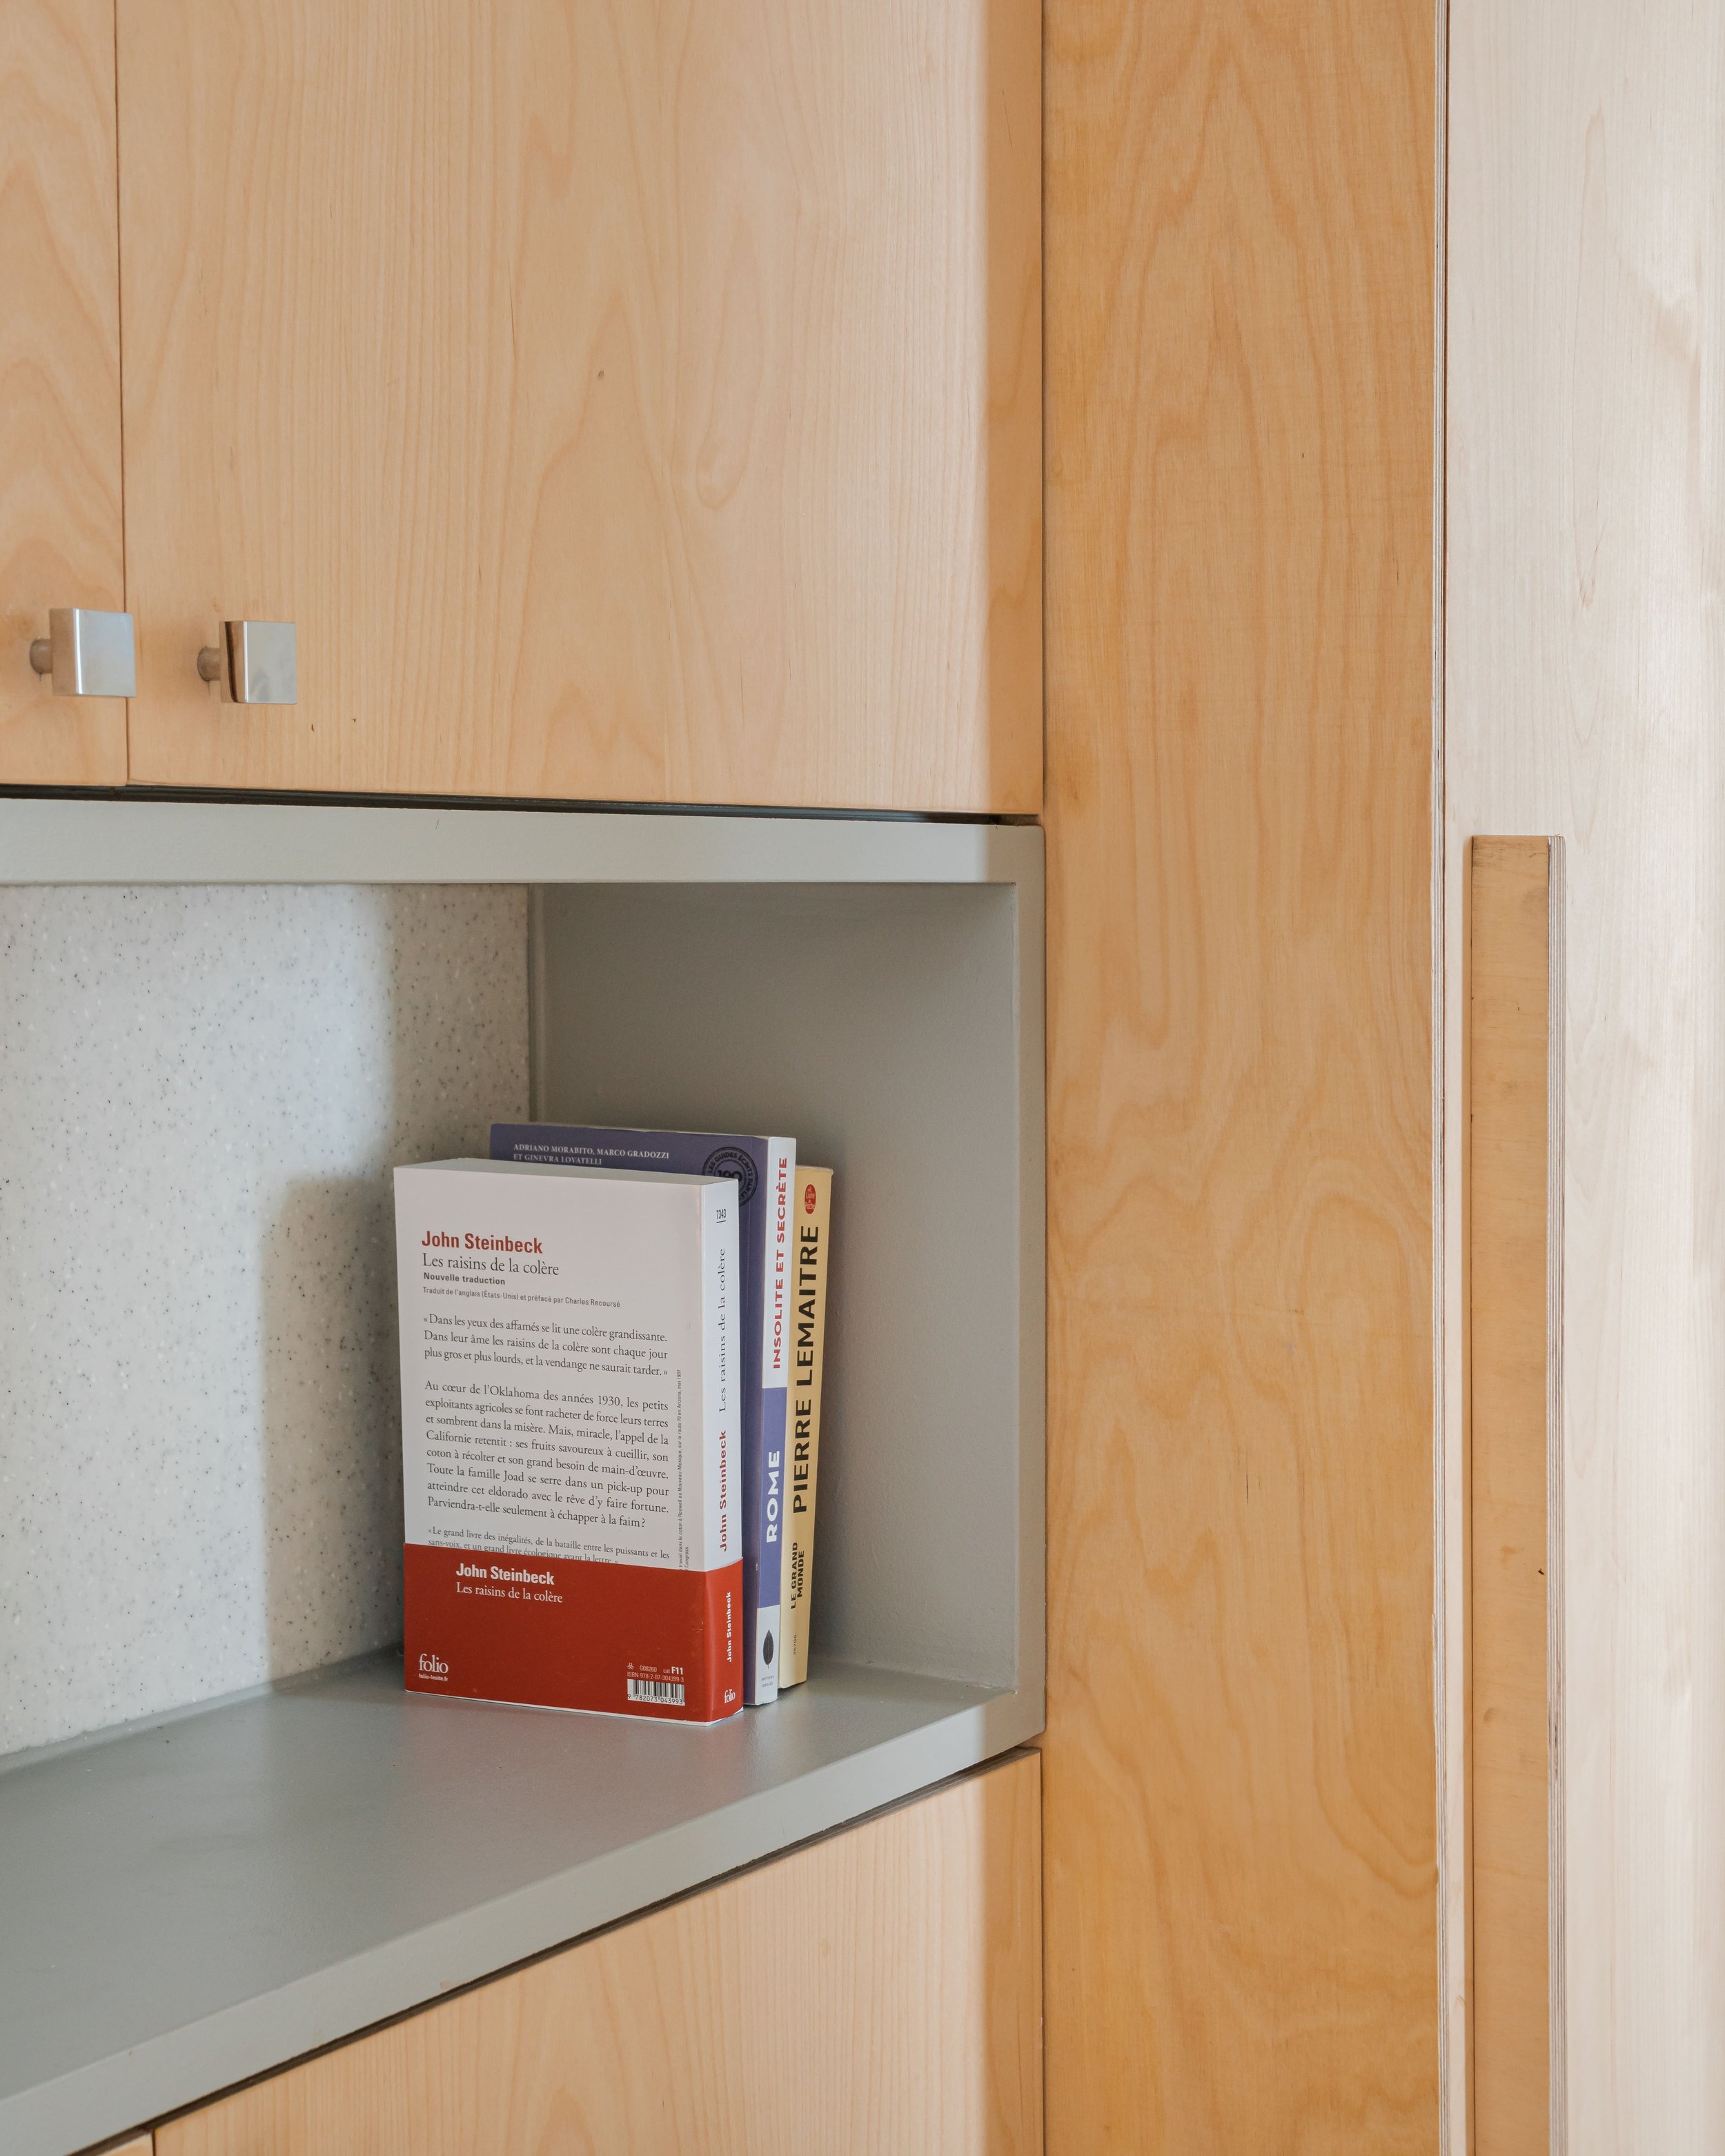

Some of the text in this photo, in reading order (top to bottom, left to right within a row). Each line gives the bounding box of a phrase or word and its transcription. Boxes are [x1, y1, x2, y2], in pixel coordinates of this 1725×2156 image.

[513, 1143, 669, 1159] ADRIANO MORABITO, MARCO GRADOZZI
[524, 1154, 559, 1164] GINEVRA
[561, 1156, 602, 1166] LOVATELLI
[716, 1209, 727, 1219] 7343
[422, 1231, 543, 1254] John Steinbeck
[423, 1253, 559, 1276] Les raisins de la colère
[773, 1158, 787, 1369] INSOLITE ET SECRÈTE
[424, 1272, 505, 1285] Nouvelle traduction
[423, 1286, 444, 1294] Traduit
[455, 1289, 480, 1298] l'anglais
[482, 1290, 518, 1300] (États-Unis)
[565, 1296, 589, 1305] Charles
[591, 1298, 620, 1307] Recoursé
[455, 1315, 466, 1326] les
[467, 1320, 488, 1329] yeux
[489, 1318, 504, 1329] des
[506, 1320, 540, 1332] affamés
[552, 1323, 561, 1334] lit
[582, 1325, 607, 1337] colère
[609, 1329, 667, 1342] grandissante.
[718, 1249, 727, 1412] Les raisins de la colère
[424, 1330, 448, 1341] Dans
[451, 1332, 468, 1343] leur
[471, 1334, 490, 1345] âme
[493, 1335, 504, 1345] les
[507, 1338, 535, 1348] raisins
[538, 1338, 549, 1349] de
[552, 1339, 560, 1350] la
[562, 1341, 589, 1352] colère
[613, 1345, 646, 1360] chaque
[649, 1348, 668, 1361] jour
[424, 1347, 442, 1360] plus
[444, 1352, 462, 1361] gros
[474, 1350, 492, 1363] plus
[493, 1352, 523, 1365] lourds,
[536, 1355, 544, 1365] la
[545, 1358, 587, 1372] vendange
[602, 1363, 631, 1373] saurait
[793, 1226, 818, 1513] PIERRE LEMAITRE
[425, 1381, 668, 1412] Au cœur de l'Oklahoma des années 1930, les petits
[425, 1397, 473, 1410] exploitants
[475, 1403, 513, 1414] agricoles
[526, 1405, 543, 1416] font
[546, 1407, 581, 1419] racheter
[583, 1410, 594, 1421] de
[596, 1411, 618, 1423] force
[620, 1413, 642, 1425] leurs
[644, 1418, 668, 1427] terres
[426, 1430, 471, 1443] Californie
[475, 1437, 506, 1447] retentit
[531, 1439, 555, 1451] fruits
[559, 1445, 604, 1456] savoureux
[607, 1447, 612, 1456] à
[615, 1448, 649, 1461] cueillir,
[718, 1431, 728, 1552] John Steinbeck
[767, 1451, 780, 1543] ROME
[428, 1496, 500, 1512] Parviendra-t-elle
[503, 1505, 547, 1518] seulement
[550, 1509, 555, 1519] à
[558, 1510, 598, 1525] échapper
[601, 1514, 606, 1523] à
[609, 1514, 616, 1525] la
[444, 1529, 464, 1538] grand
[466, 1530, 482, 1539] livre
[484, 1531, 495, 1541] des
[498, 1534, 533, 1545] inégalités,
[535, 1537, 544, 1545] de
[546, 1538, 553, 1546] la
[555, 1539, 581, 1550] bataille
[604, 1543, 613, 1553] les
[615, 1547, 649, 1556] puissants
[660, 1550, 669, 1559] les
[456, 1563, 555, 1585] John Steinbeck
[457, 1582, 562, 1603] Les raisins de la colère
[791, 1594, 796, 1609] LE
[419, 1654, 448, 1673] folio
[640, 1674, 684, 1682] 978-2-07-304399-3
[724, 1689, 736, 1703] folio
